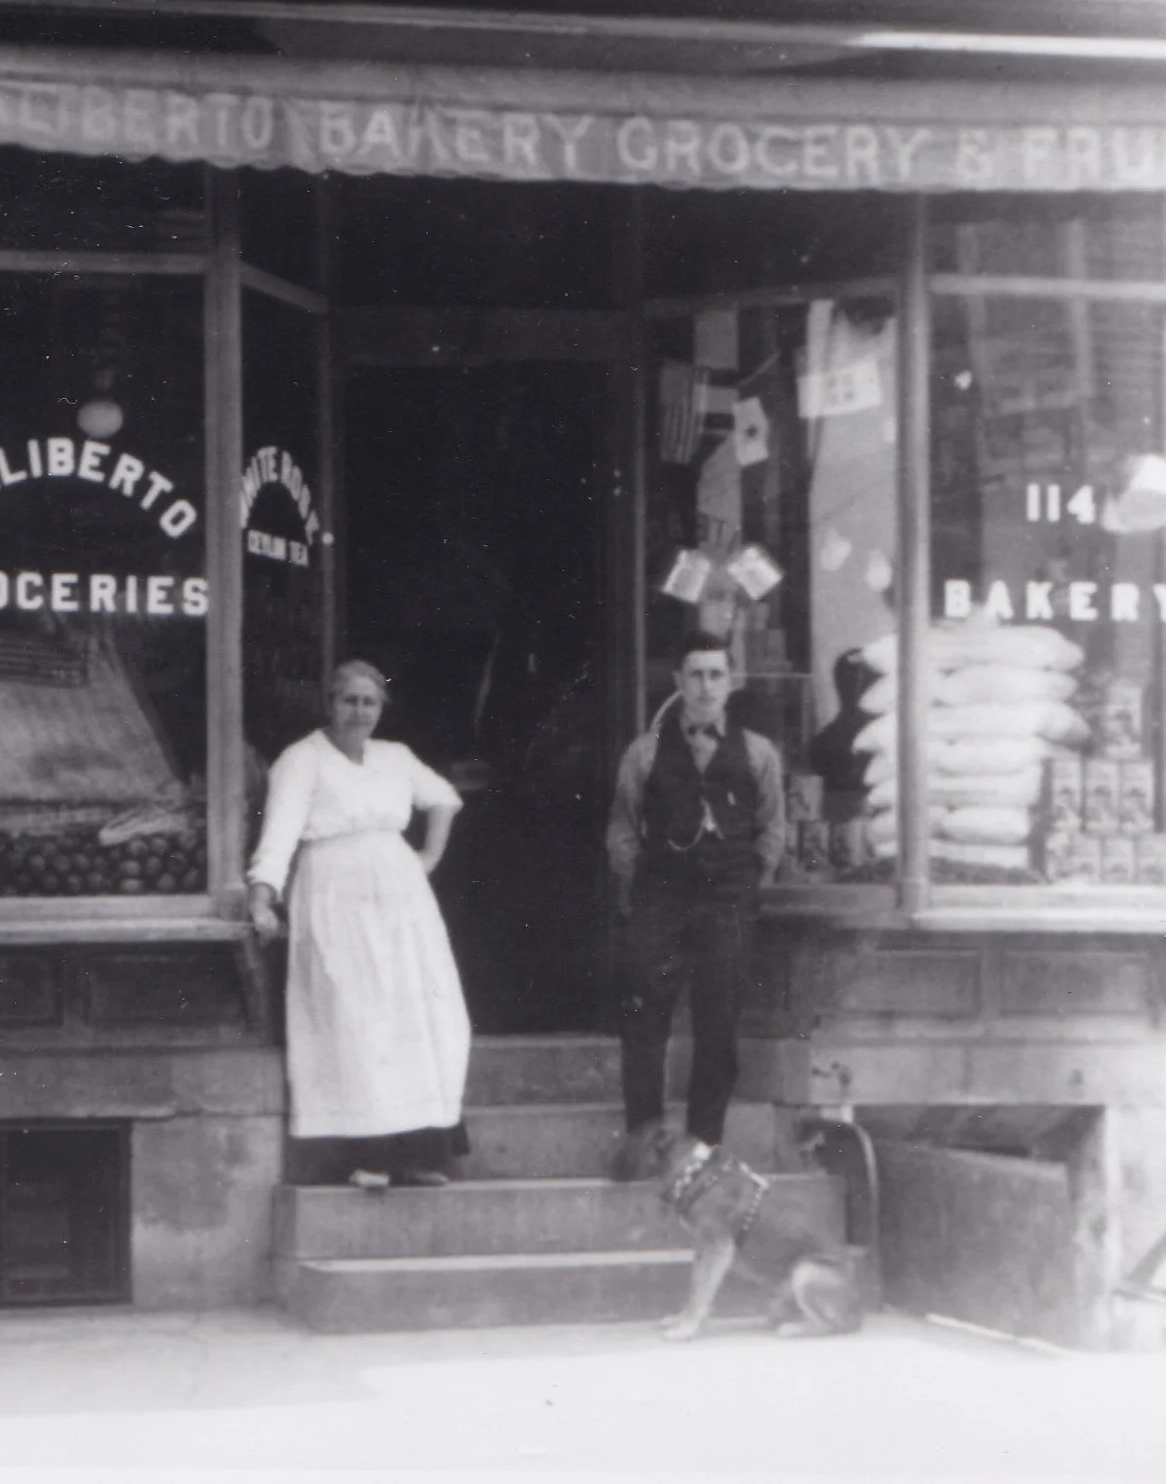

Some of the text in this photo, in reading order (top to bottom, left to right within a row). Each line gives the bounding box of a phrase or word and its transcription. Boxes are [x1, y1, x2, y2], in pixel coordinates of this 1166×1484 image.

[319, 99, 596, 170] BAKERY
[616, 116, 931, 181] GROCERY
[955, 127, 993, 180] &
[1021, 126, 1166, 181] FRU
[1026, 483, 1096, 524] 114
